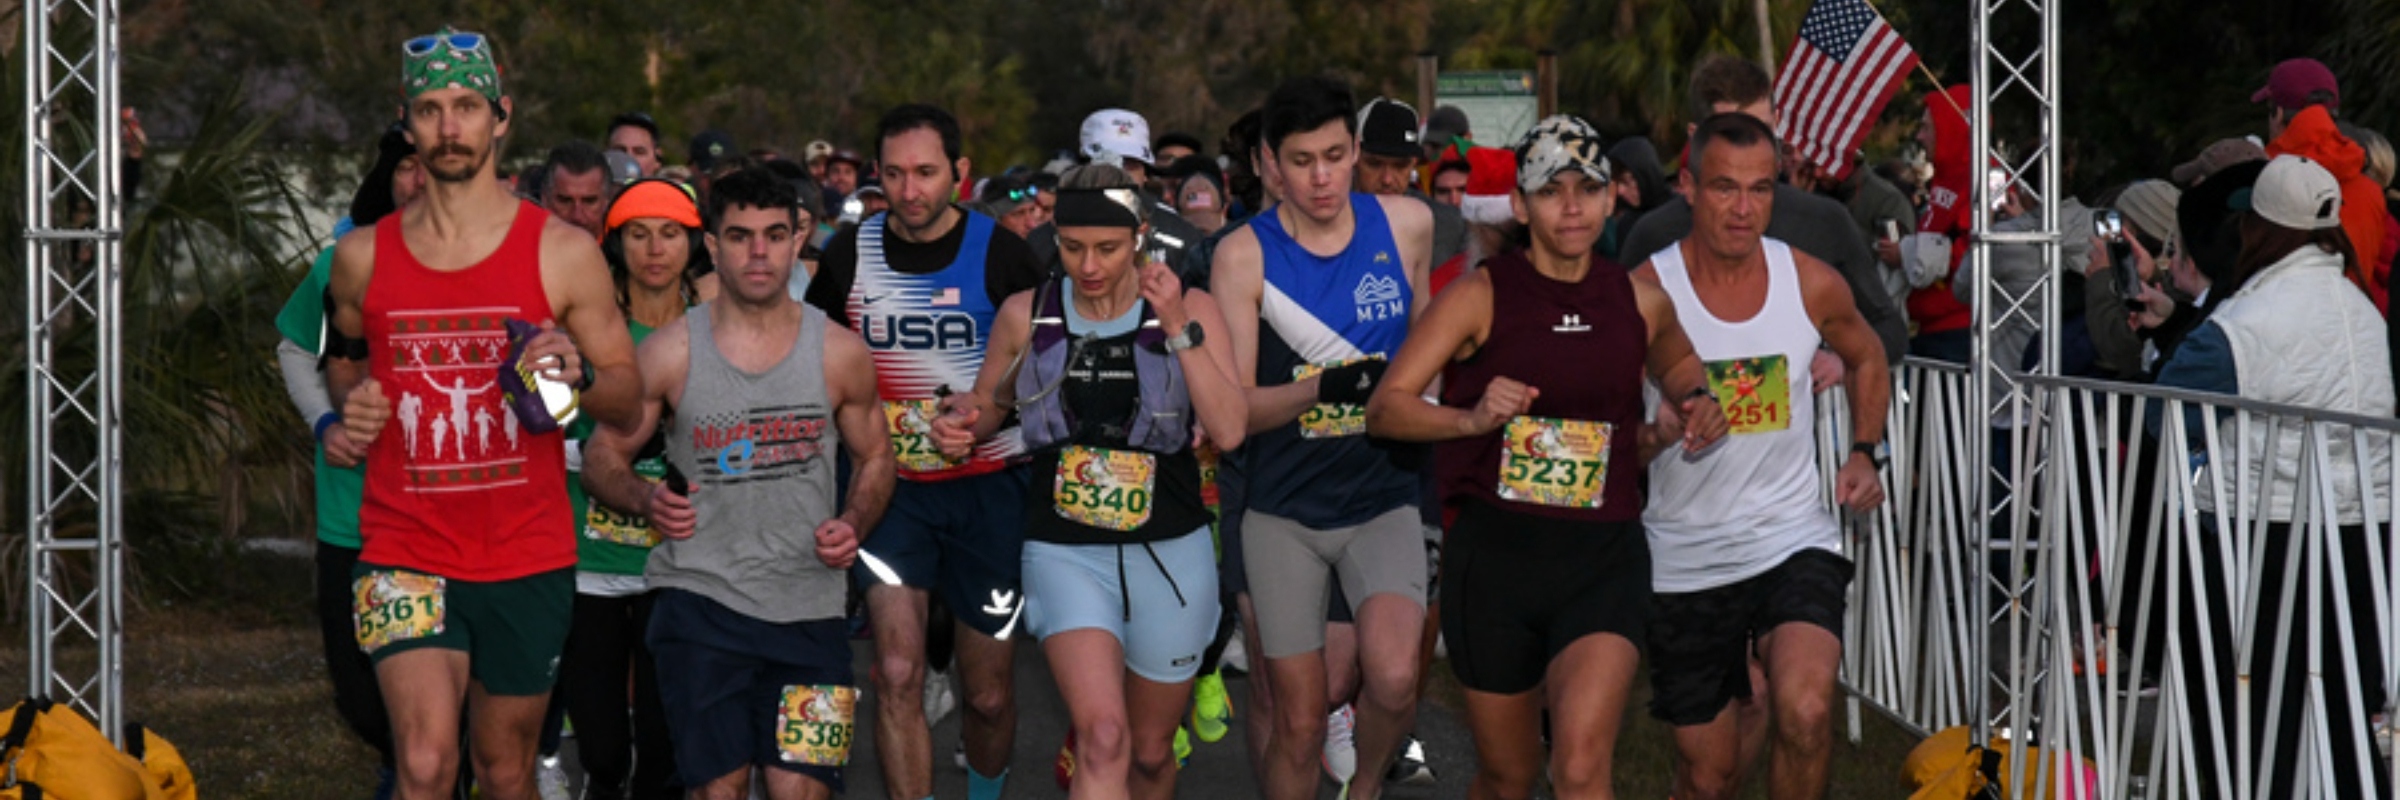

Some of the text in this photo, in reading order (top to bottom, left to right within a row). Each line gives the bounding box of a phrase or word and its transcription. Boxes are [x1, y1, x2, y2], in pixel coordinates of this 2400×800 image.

[862, 313, 977, 350] USA
[1727, 401, 1778, 425] 251
[693, 413, 827, 450] Nutrition
[1506, 453, 1601, 489] 5237
[1060, 480, 1147, 514] 5340
[359, 594, 437, 639] 5361
